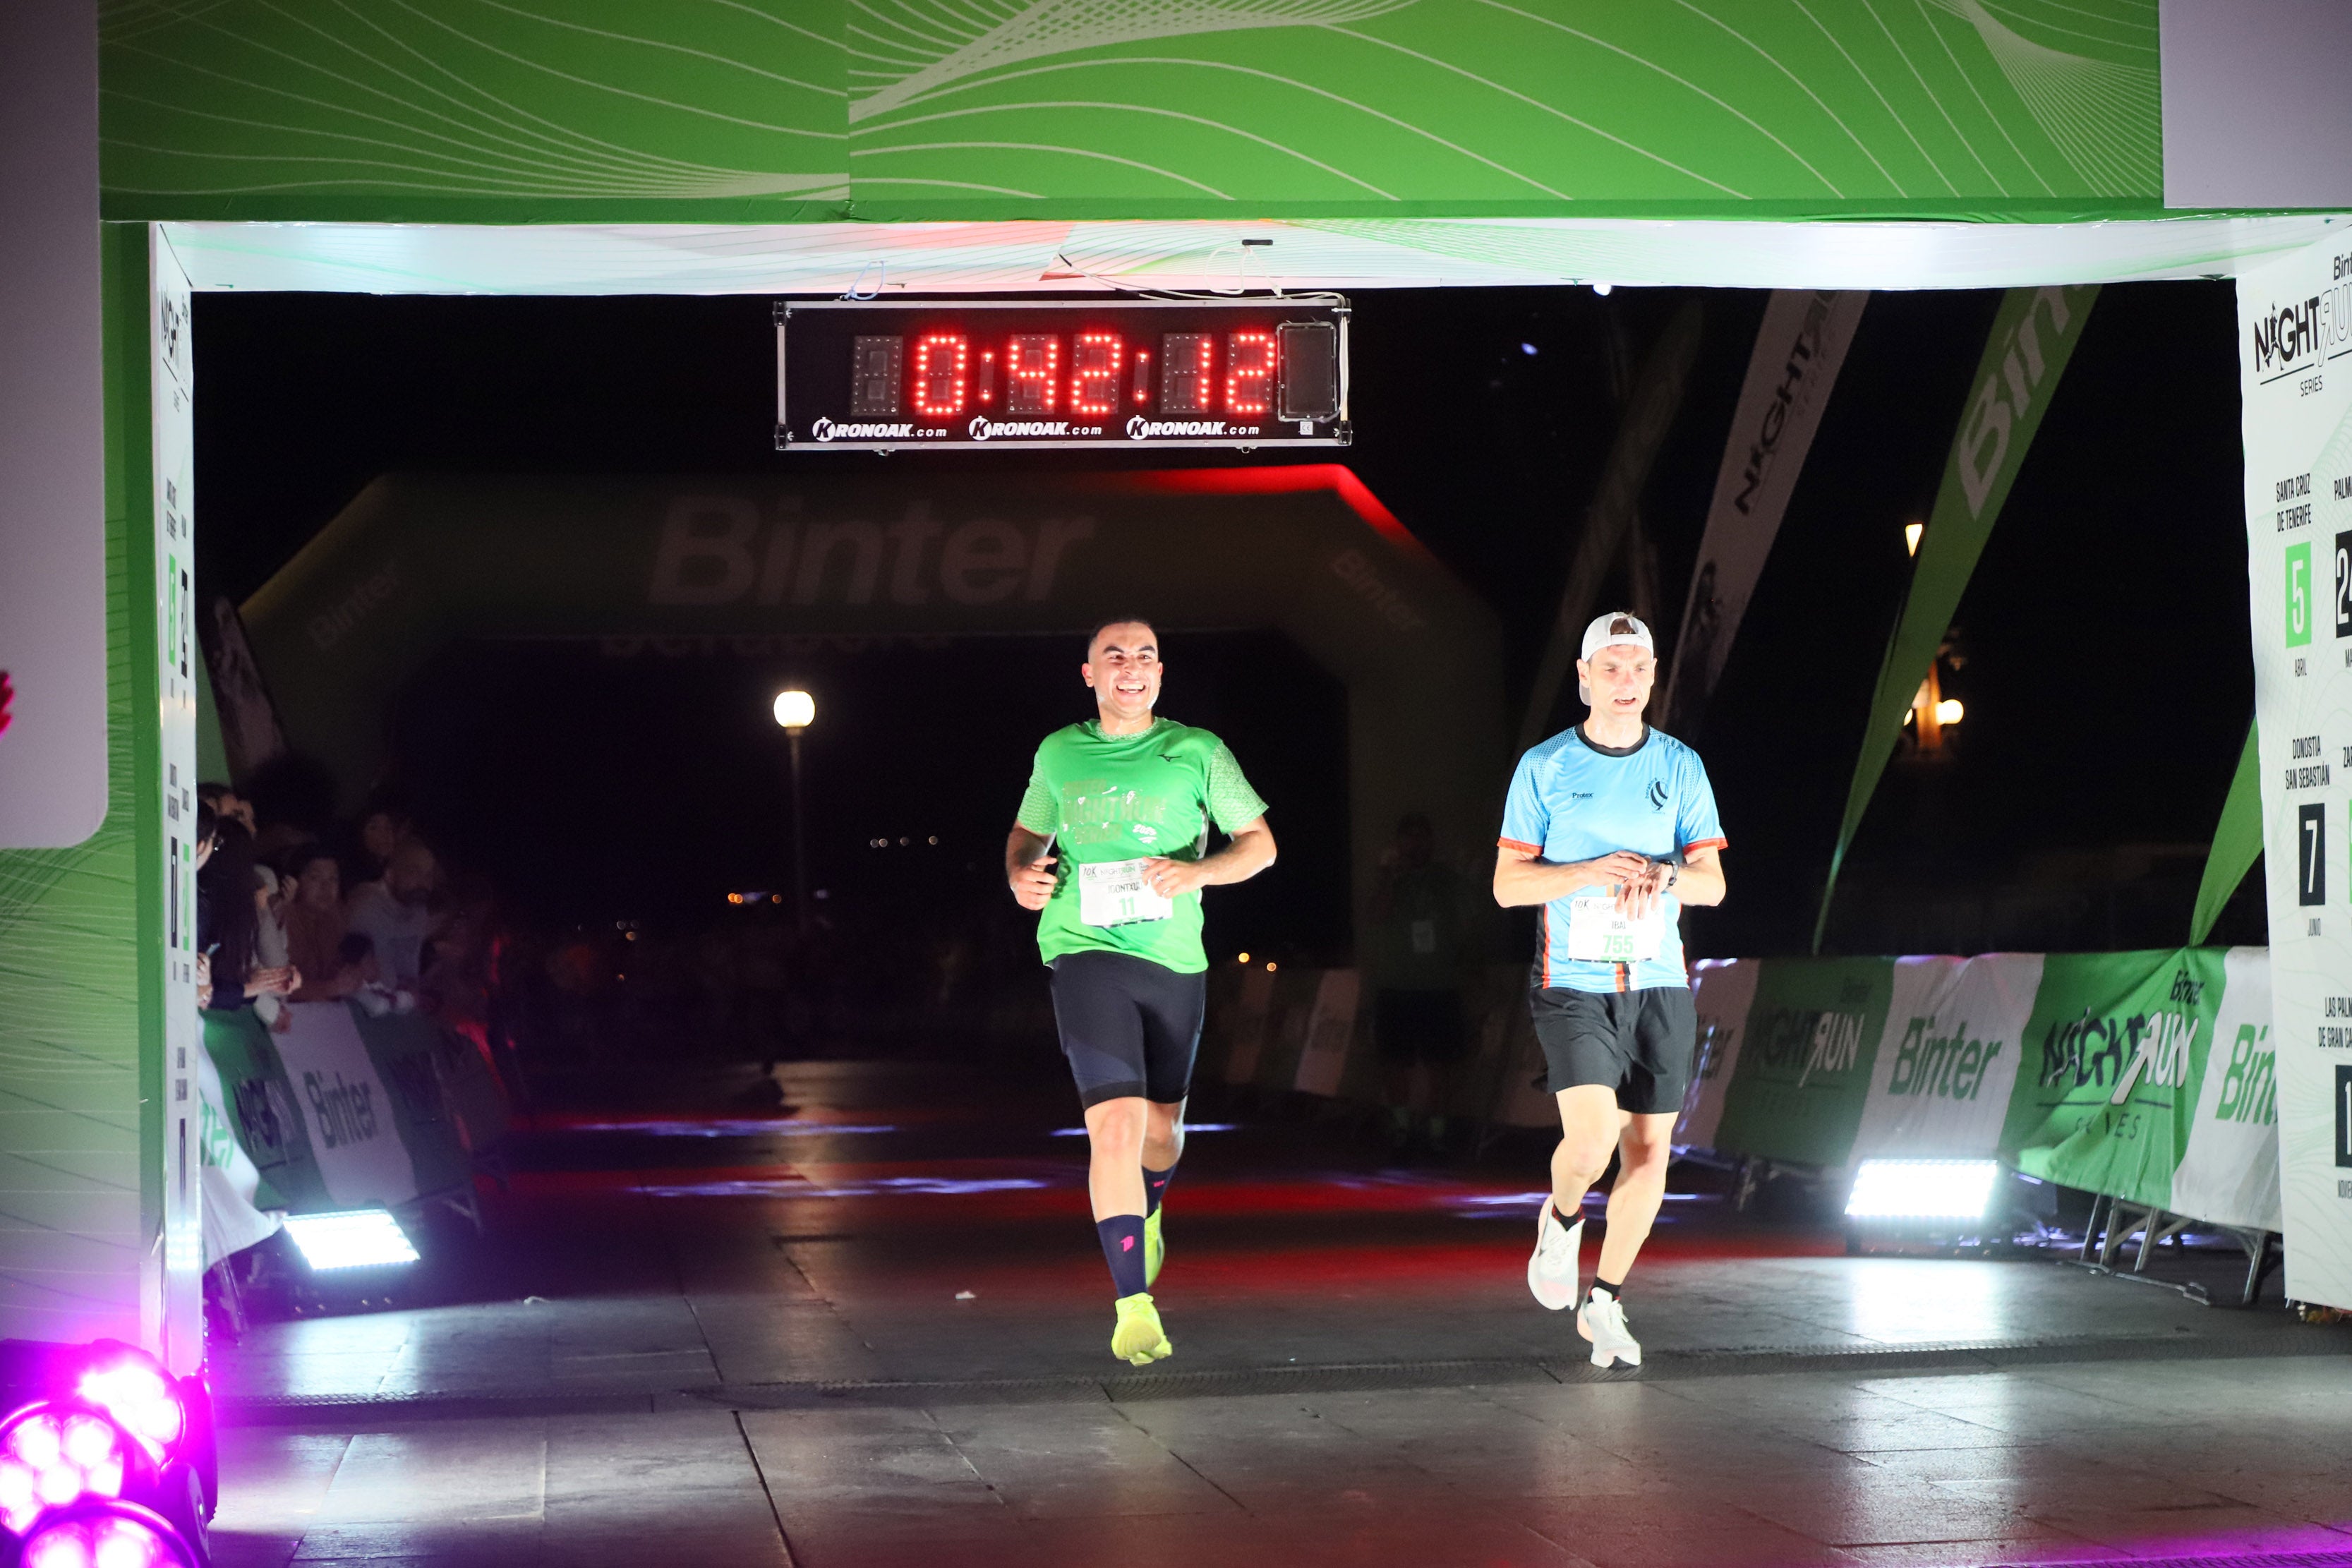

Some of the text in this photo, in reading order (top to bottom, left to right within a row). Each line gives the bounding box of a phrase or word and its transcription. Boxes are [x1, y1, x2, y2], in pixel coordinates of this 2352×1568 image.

[2318, 282, 2352, 368] RU
[2300, 375, 2323, 397] SERIES
[1958, 284, 2085, 521] Bin
[812, 417, 947, 442] KRONOAK.com
[969, 416, 1102, 440] KRONOAK.com
[1126, 415, 1260, 440] KRONOAK.com
[2276, 473, 2310, 503] SANTA CRUZ
[2334, 476, 2352, 501] PALM
[2277, 503, 2312, 532] DE TENERIFE
[646, 494, 1097, 607] Binter
[2292, 560, 2305, 634] 5
[2295, 658, 2307, 677] ABRIL
[2293, 735, 2321, 759] DONOSTIA
[2286, 768, 2297, 790] SAN
[2305, 819, 2317, 893] 7
[1083, 866, 1097, 877] 10K
[1119, 897, 1135, 916] 11
[1574, 899, 1589, 910] 10K
[1612, 921, 1626, 929] IBAI
[1603, 935, 1634, 953] 755
[2325, 997, 2336, 1018] LAS
[2318, 1027, 2326, 1047] DE
[2327, 1027, 2344, 1048] GRAN
[1888, 1017, 2002, 1100] Binter
